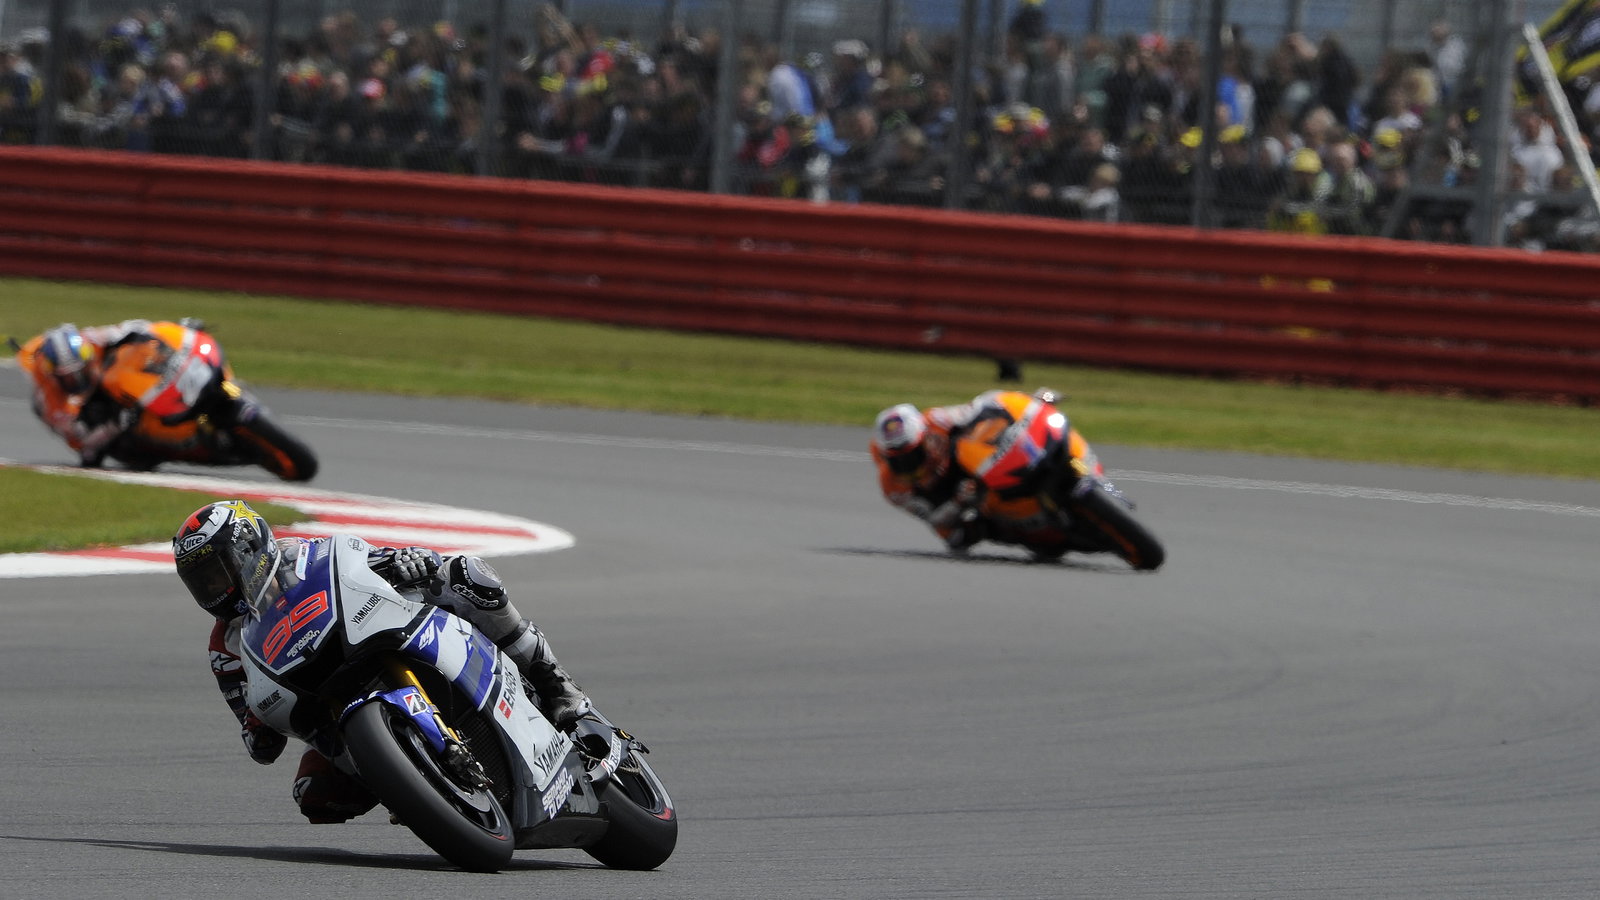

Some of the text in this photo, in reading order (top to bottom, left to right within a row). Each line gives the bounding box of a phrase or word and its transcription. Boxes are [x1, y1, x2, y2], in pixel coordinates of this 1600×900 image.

[262, 590, 329, 665] 99
[351, 593, 382, 624] YAMALUBE
[534, 732, 565, 777] YAMAHA
